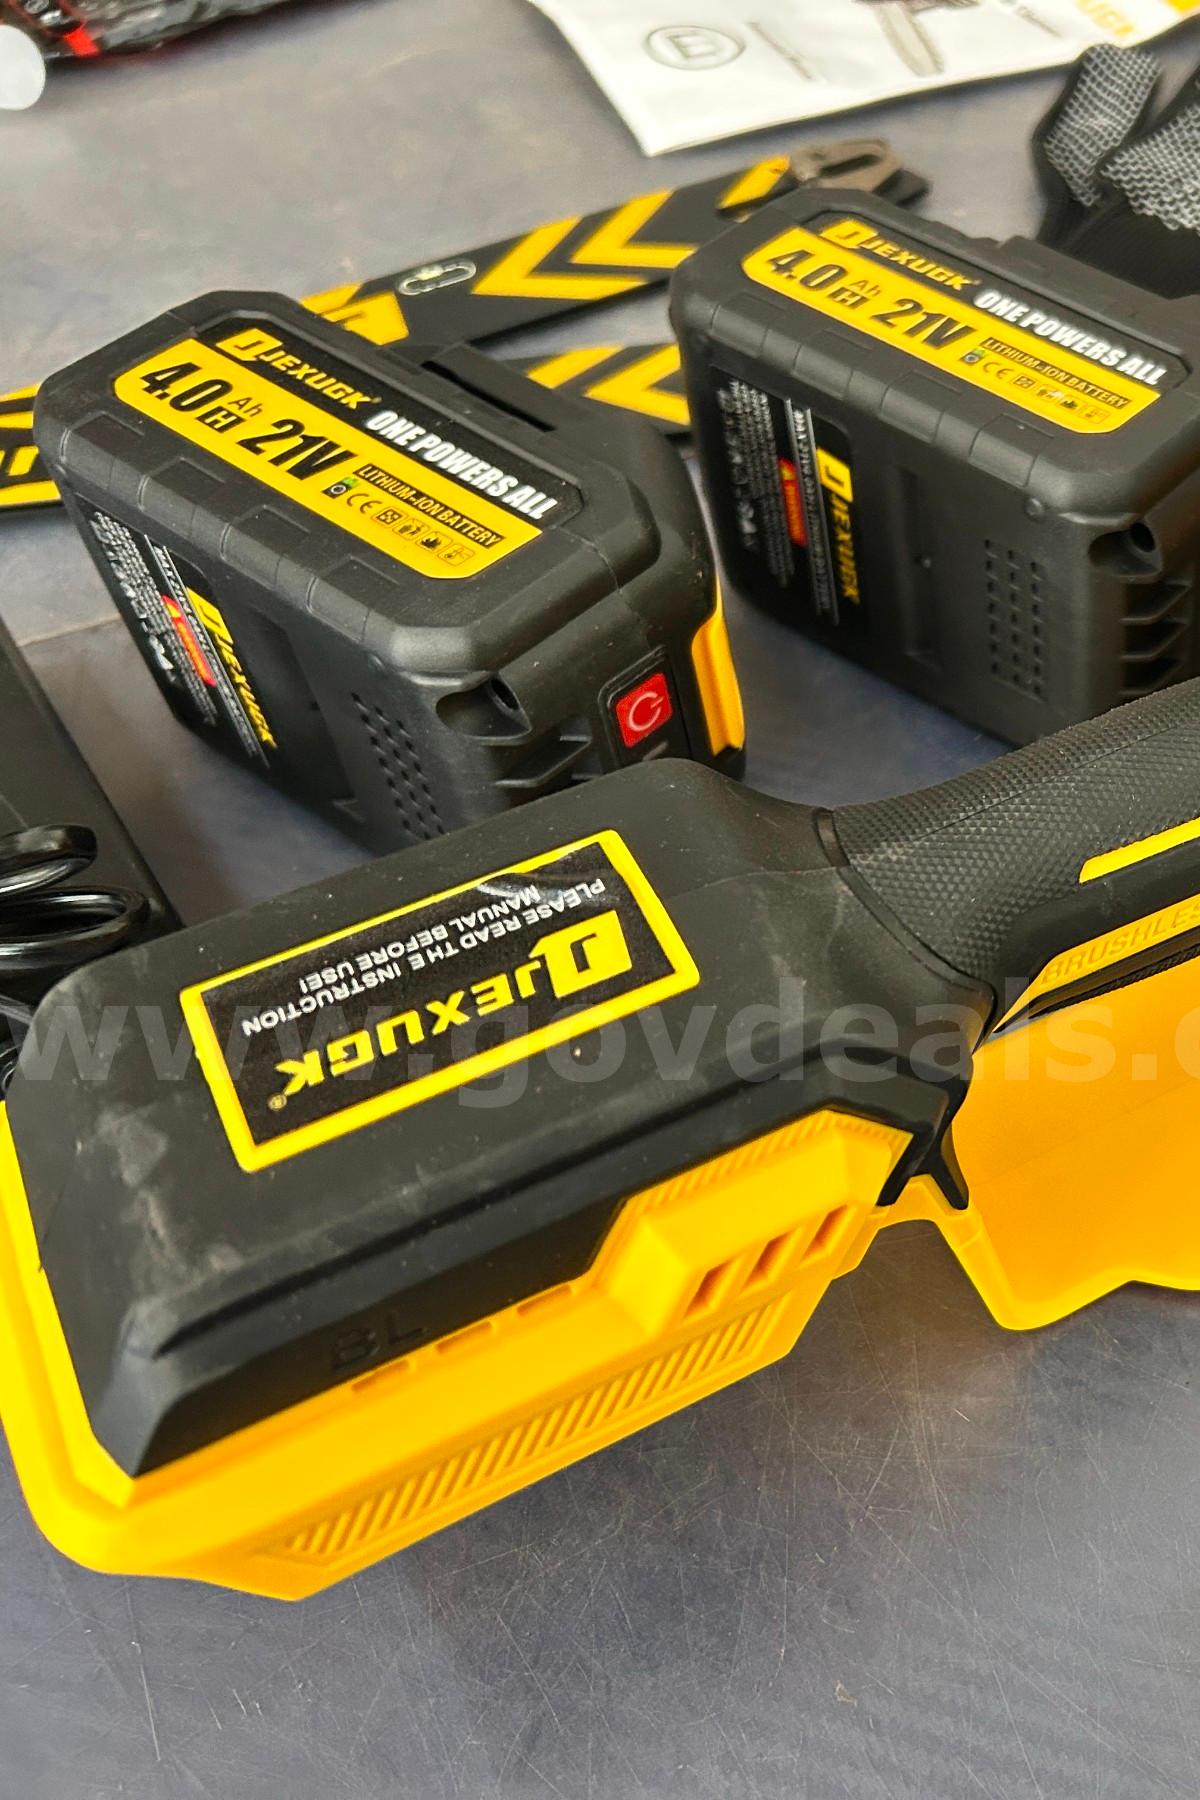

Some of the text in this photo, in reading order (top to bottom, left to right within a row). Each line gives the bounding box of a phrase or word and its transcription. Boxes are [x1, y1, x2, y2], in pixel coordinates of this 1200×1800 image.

[767, 249, 977, 350] 4.0 Ah 21V
[973, 289, 1167, 386] ONE POWERS ALL
[139, 361, 358, 480] 4.0 Ah 21V
[1065, 377, 1130, 410] BATTERY
[358, 465, 502, 548] LITHIUM-ION BATTERY
[365, 410, 558, 520] ONE POWERS ALL
[299, 884, 542, 995] MANUAL BEFORE USE!
[460, 914, 522, 950] READ
[527, 878, 606, 926] PLEASE
[241, 961, 402, 1037] INSTRUCTION
